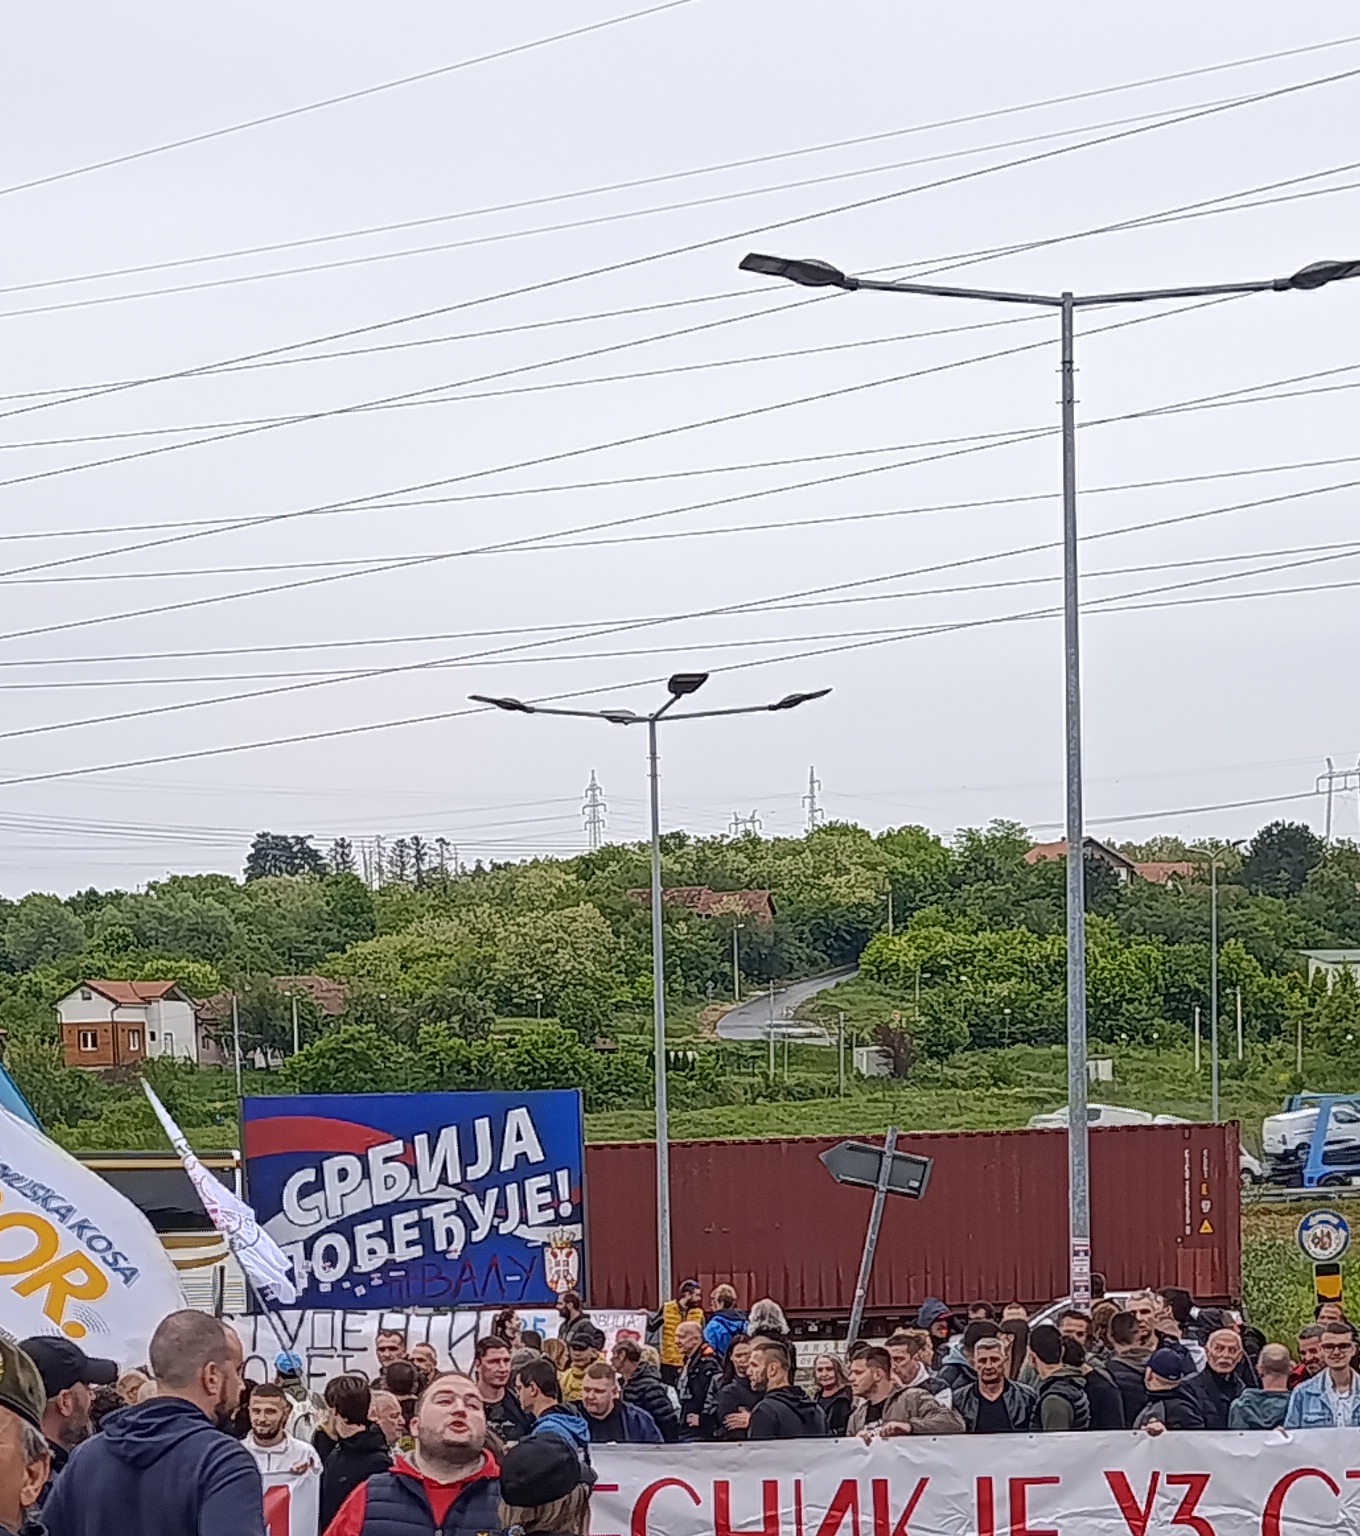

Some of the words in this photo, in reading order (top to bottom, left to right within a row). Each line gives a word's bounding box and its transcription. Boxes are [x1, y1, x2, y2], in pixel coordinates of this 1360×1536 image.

[283, 1106, 545, 1226] СРБИЈА
[65, 1217, 140, 1288] KOSA
[232, 1309, 481, 1353] ТУДЕНТИ
